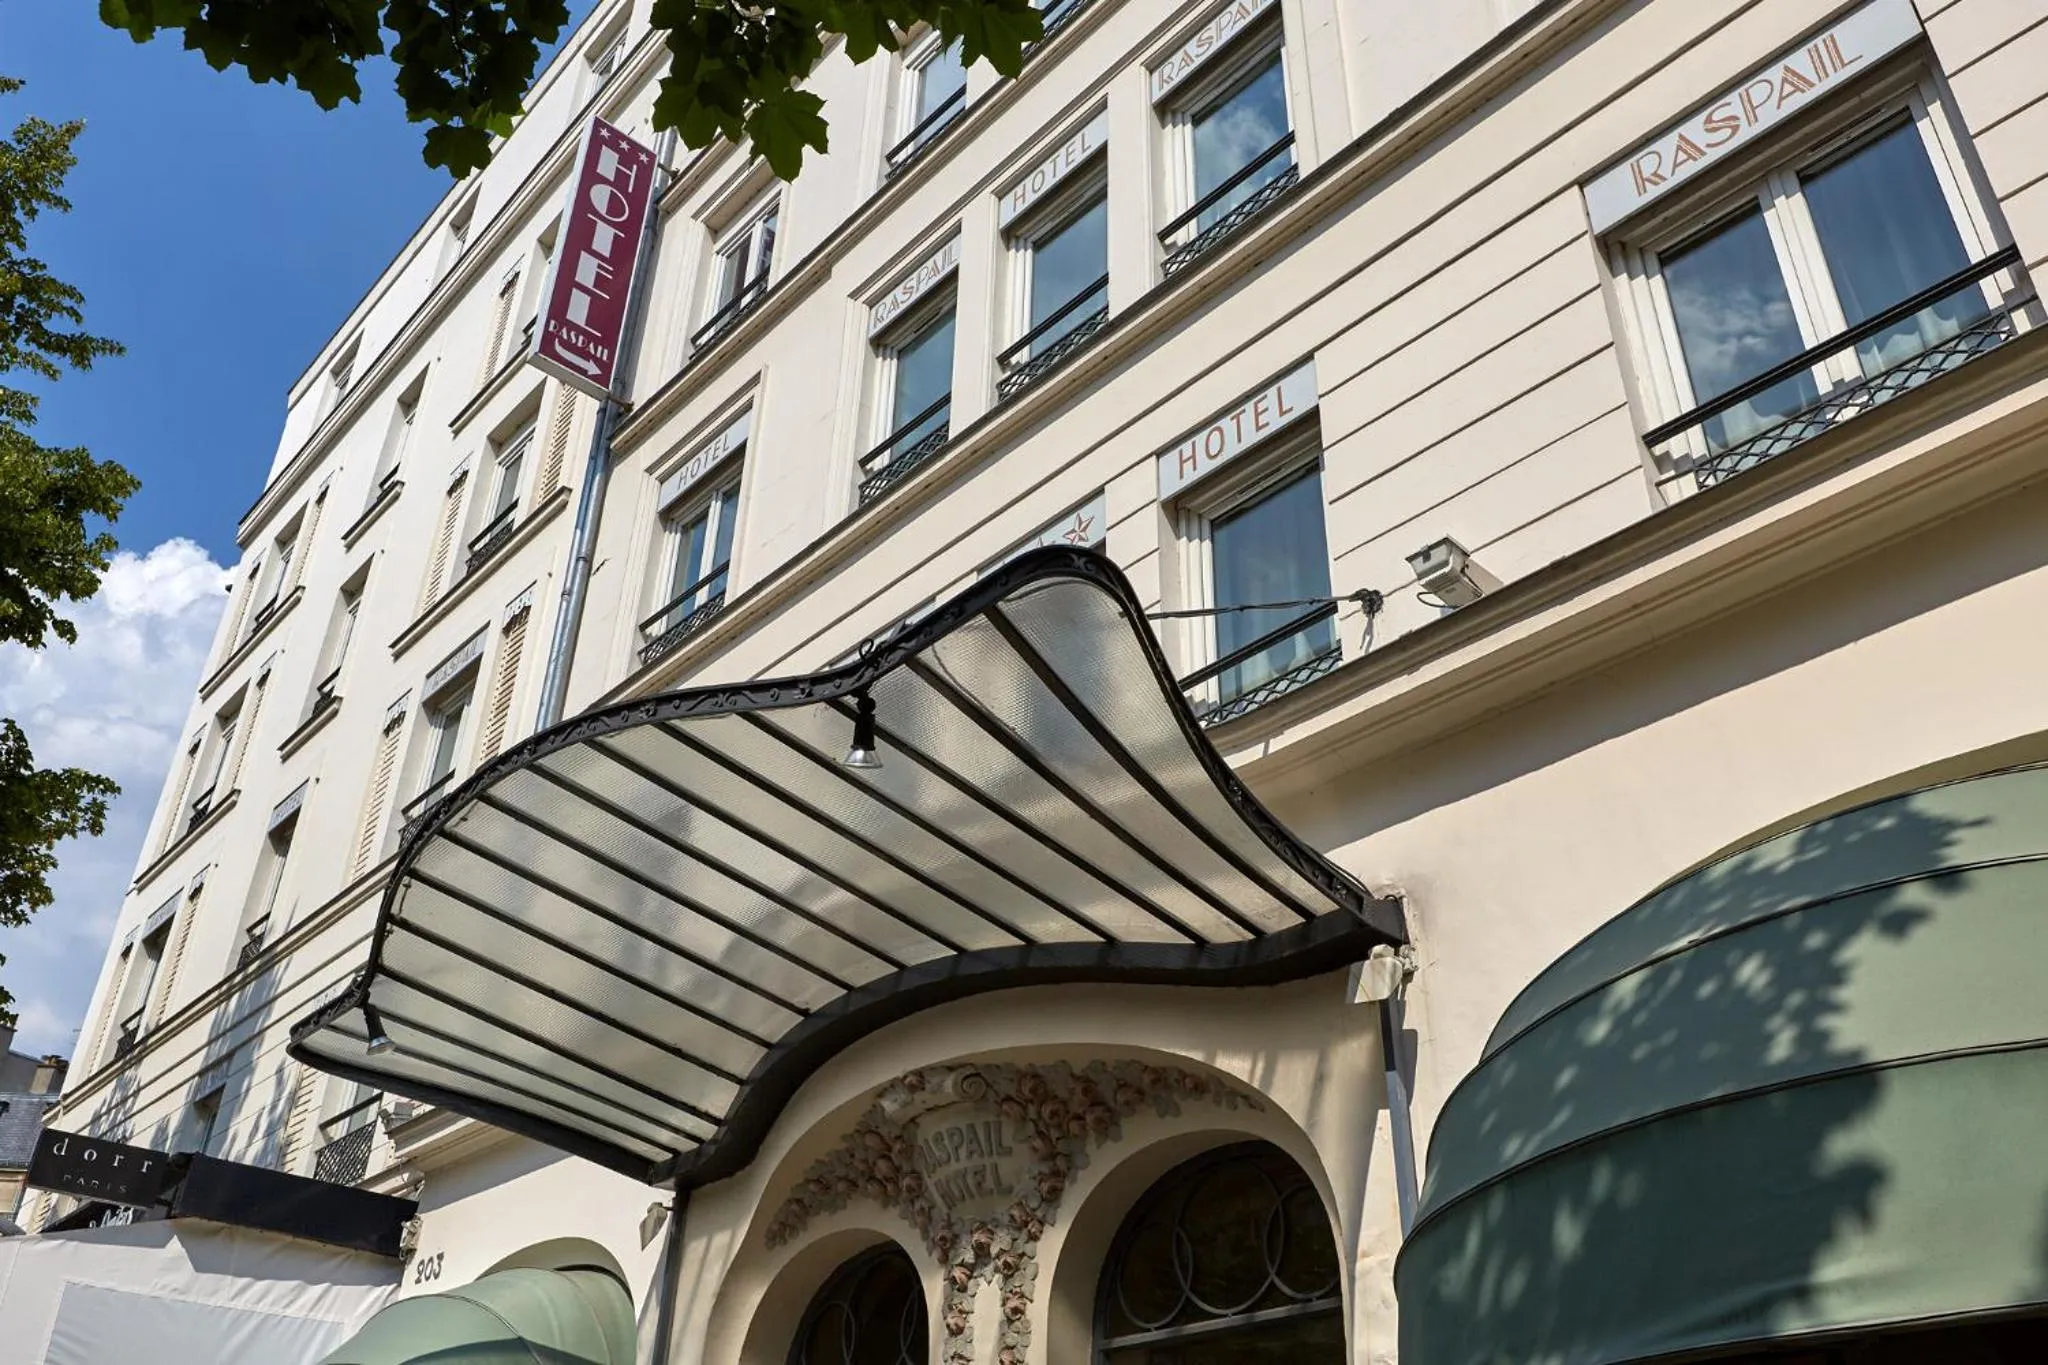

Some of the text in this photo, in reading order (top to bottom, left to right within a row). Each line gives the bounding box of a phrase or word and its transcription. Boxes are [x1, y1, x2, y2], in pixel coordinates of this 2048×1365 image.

[1629, 33, 1864, 198] RASPAIL
[1012, 133, 1093, 213] HOTEL
[566, 144, 637, 337] HOTEL
[873, 243, 958, 328] RASPAIL
[548, 319, 610, 362] RASPAIL
[677, 433, 730, 491] HOTEL
[1178, 385, 1294, 480] HOTEL
[53, 1137, 152, 1173] dorr
[414, 1250, 445, 1285] 203
